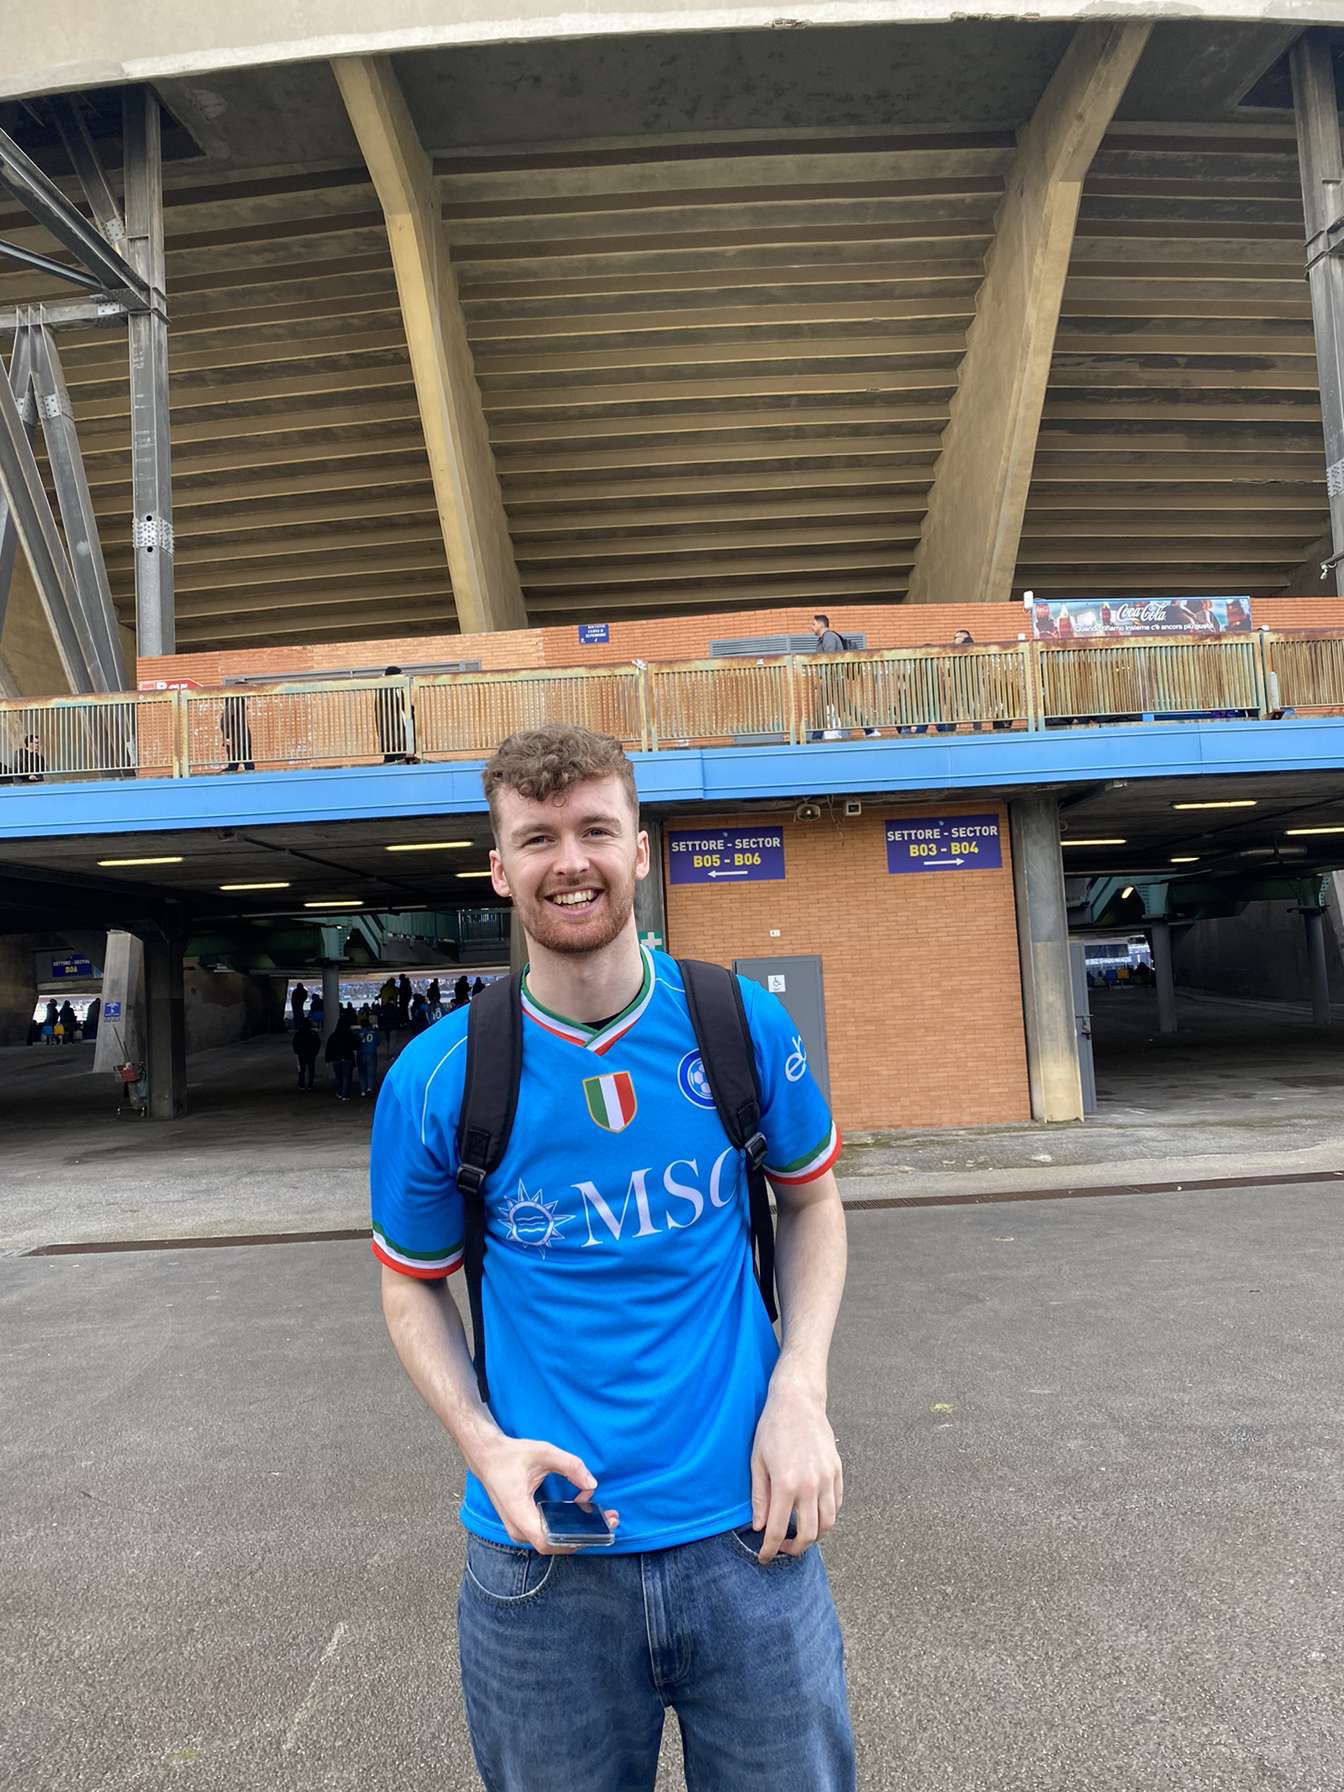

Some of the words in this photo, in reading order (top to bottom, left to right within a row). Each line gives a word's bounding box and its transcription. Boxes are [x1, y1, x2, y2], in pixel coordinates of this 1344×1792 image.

[1161, 623, 1183, 631] ancora
[887, 828, 941, 841] SETTORE
[951, 825, 998, 838] SECTOR
[671, 840, 725, 852] SETTORE
[734, 837, 781, 849] SECTOR
[909, 843, 937, 857] B03
[950, 841, 979, 855] B04
[693, 854, 721, 868] B05
[733, 852, 761, 866] B06
[570, 1146, 737, 1248] MSC
